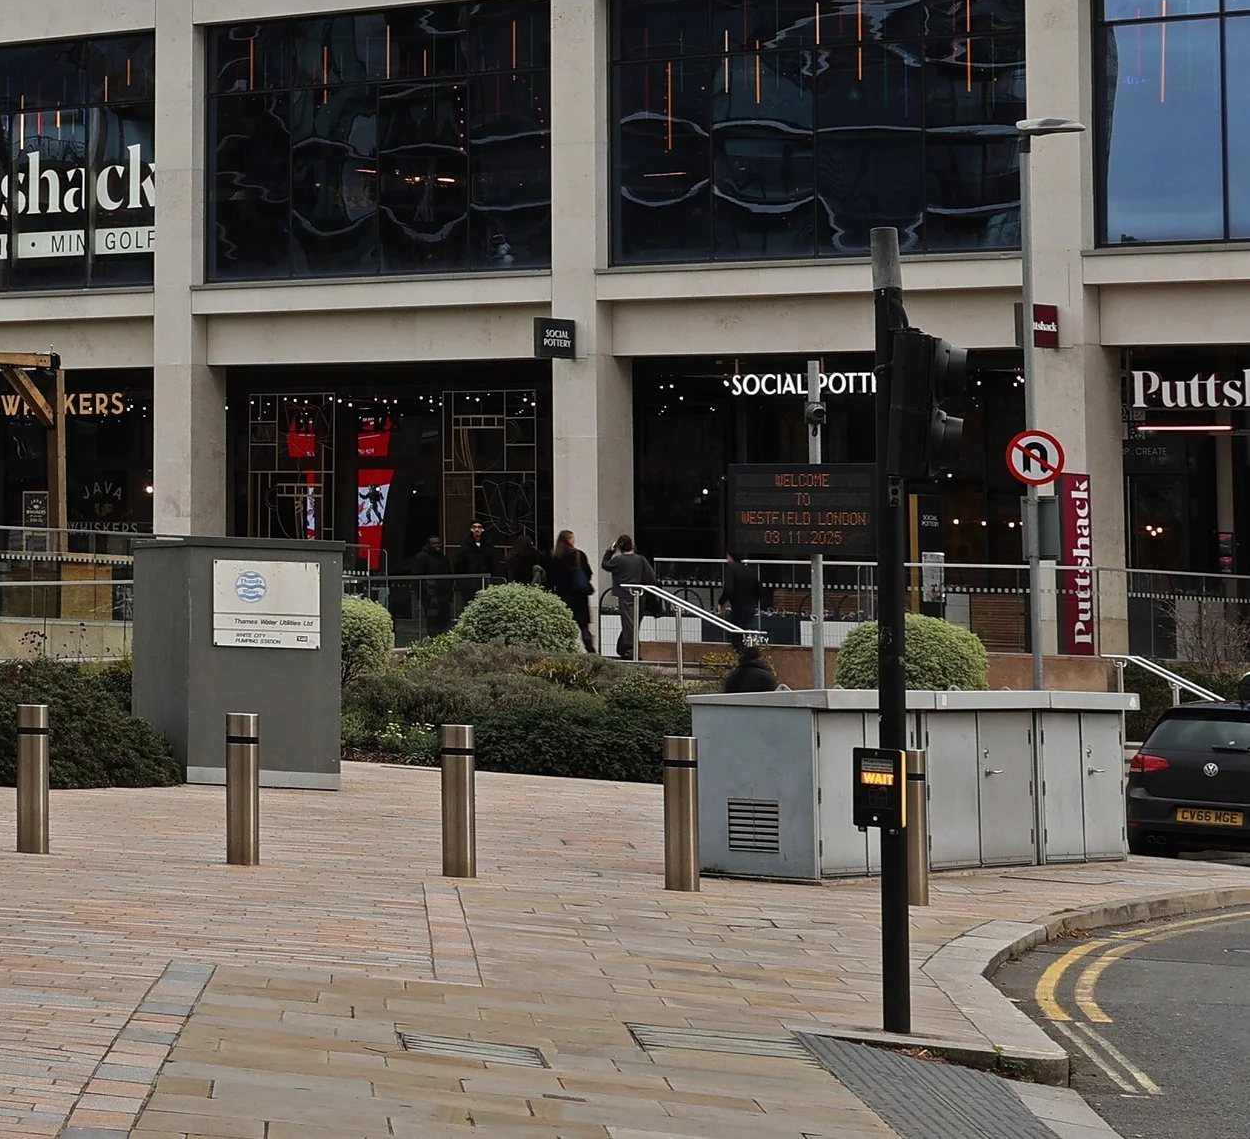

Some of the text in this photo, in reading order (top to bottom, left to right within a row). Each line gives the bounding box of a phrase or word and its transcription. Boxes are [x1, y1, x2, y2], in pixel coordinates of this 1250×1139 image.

[51, 234, 86, 253] MIN
[545, 329, 570, 339] SOCIAL
[543, 338, 572, 348] POTTERY
[731, 372, 878, 396] SOCIAL POTT
[1131, 370, 1250, 408] Putts
[775, 473, 830, 488] WELCOME
[795, 493, 811, 506] TO
[741, 511, 867, 526] WESTFIELD LONDON
[1070, 479, 1093, 645] Puttshack
[234, 618, 258, 626] Thames
[279, 619, 301, 627] Utilities
[862, 772, 894, 786] WAIT
